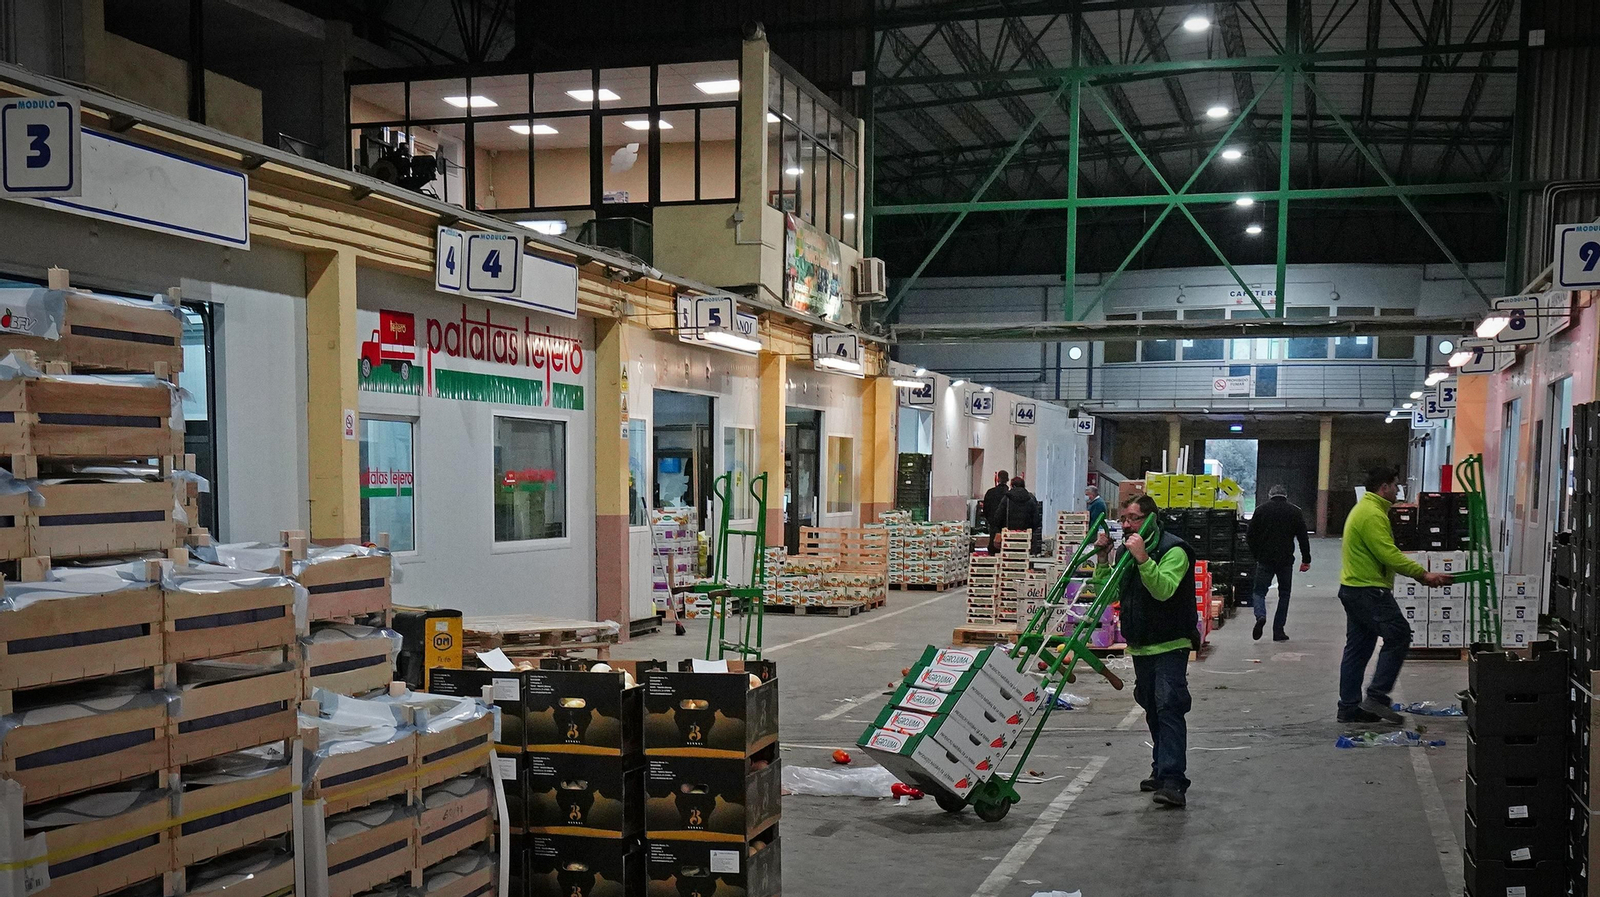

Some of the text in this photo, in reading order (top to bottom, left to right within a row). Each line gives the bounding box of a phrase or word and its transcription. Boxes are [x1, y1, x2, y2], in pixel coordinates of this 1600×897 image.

[18, 100, 55, 109] MODULO
[27, 124, 51, 168] 3
[446, 246, 455, 275] 4
[482, 250, 502, 278] 4
[1579, 241, 1600, 271] 9
[709, 308, 721, 327] 5
[1510, 309, 1526, 330] 8
[426, 304, 583, 406] patatas tejero
[1473, 346, 1484, 364] 7
[912, 384, 931, 398] 42
[1443, 388, 1456, 401] 3
[973, 397, 991, 410] 43
[1018, 408, 1033, 419] 44
[1079, 421, 1090, 430] 45
[437, 637, 449, 645] OM
